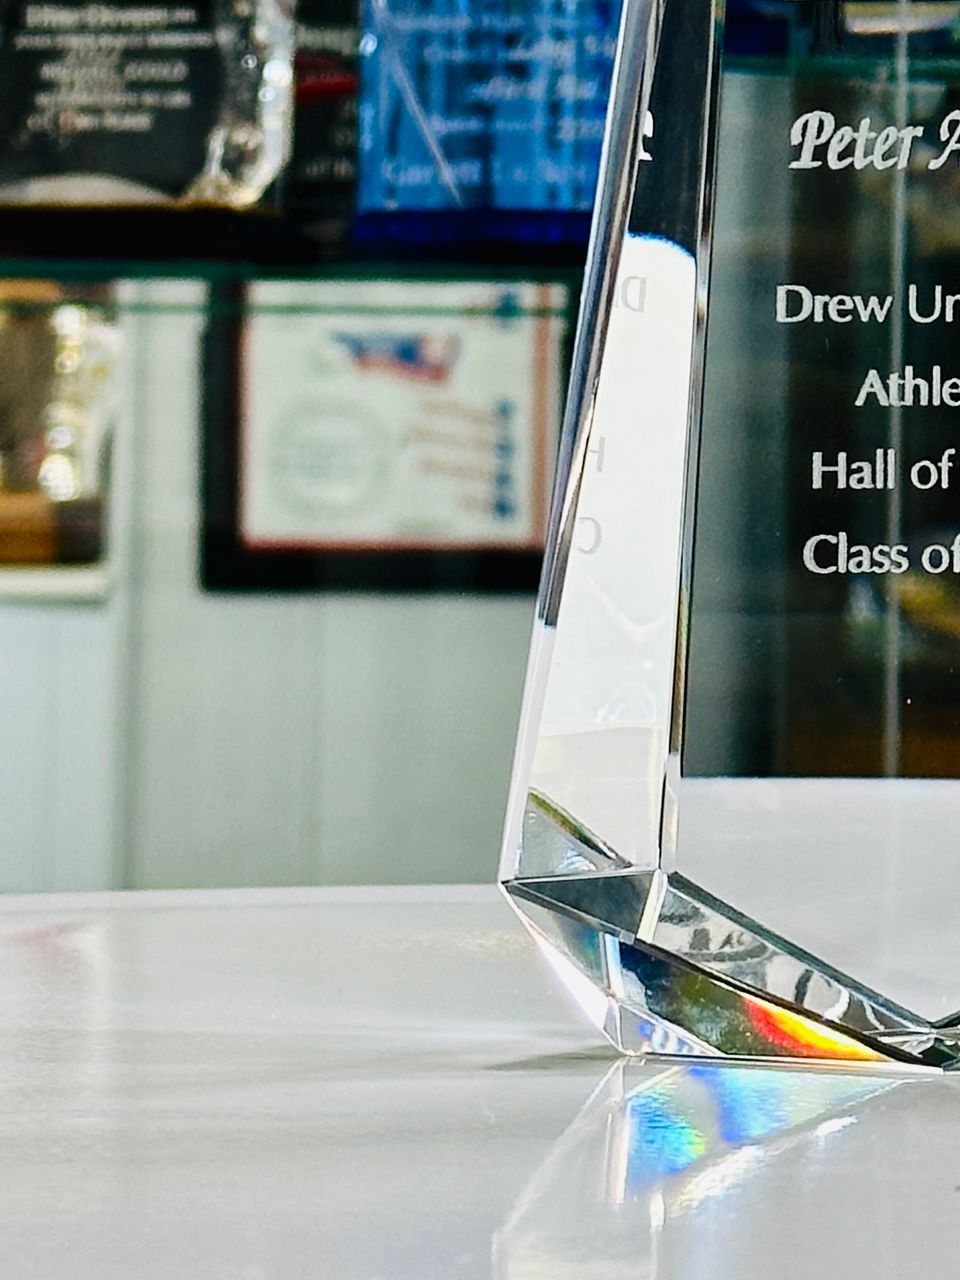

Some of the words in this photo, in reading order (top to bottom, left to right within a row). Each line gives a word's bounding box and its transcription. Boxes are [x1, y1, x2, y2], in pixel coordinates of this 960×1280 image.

[788, 109, 924, 171] Peter
[775, 284, 894, 324] Drew
[811, 448, 896, 490] Hall
[910, 448, 957, 490] of
[802, 531, 910, 575] Class
